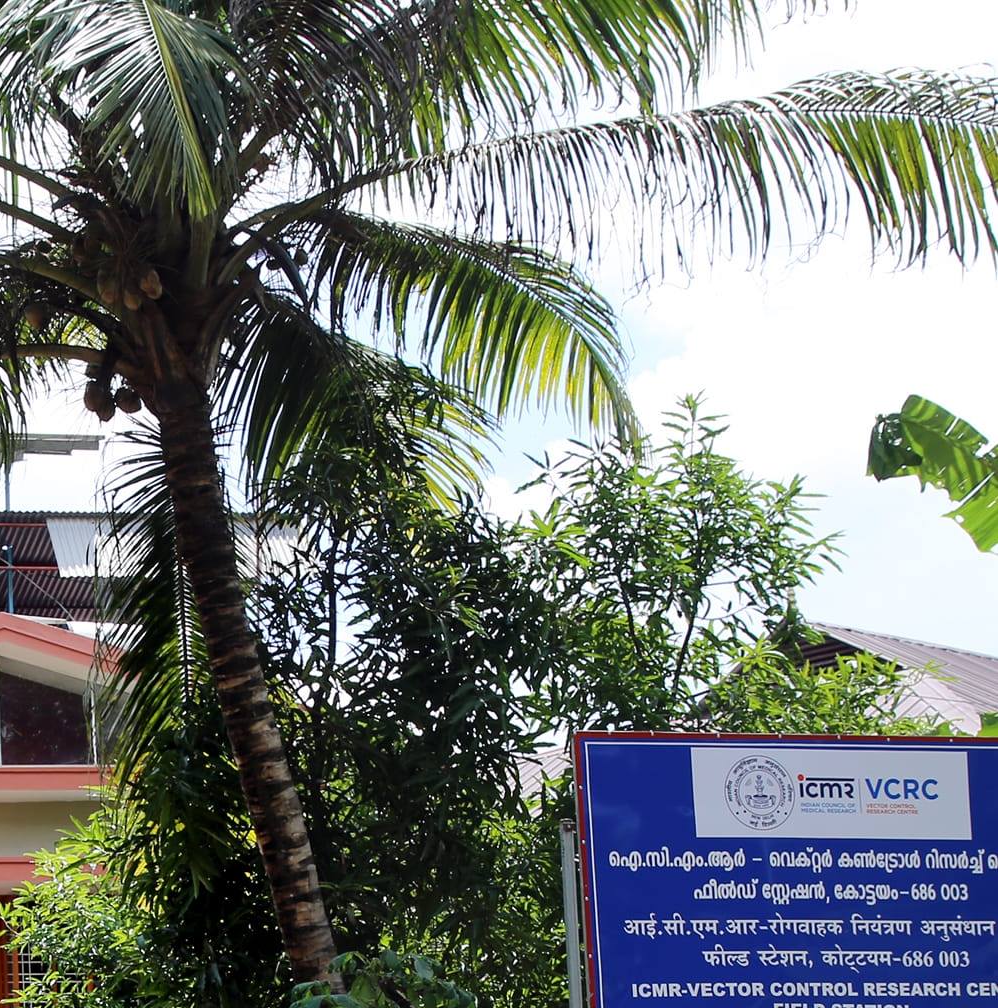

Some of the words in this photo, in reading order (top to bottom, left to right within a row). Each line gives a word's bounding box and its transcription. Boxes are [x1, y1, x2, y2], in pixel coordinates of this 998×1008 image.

[865, 778, 939, 800] VCRC
[694, 878, 758, 900] ഫീൽഡ്
[941, 884, 968, 900] 003
[624, 913, 843, 939] आई.सी.एम.आर-रोगवाहक
[851, 914, 912, 935] नियंत्रण
[920, 915, 995, 942] अनुसंधान
[702, 944, 750, 966] फील्ड
[757, 944, 813, 968] स्टेशन,
[939, 950, 970, 967] 003
[632, 983, 765, 998] ICMR-VECTOR
[770, 983, 858, 997] CONTROL
[864, 983, 960, 996] RESEARCH
